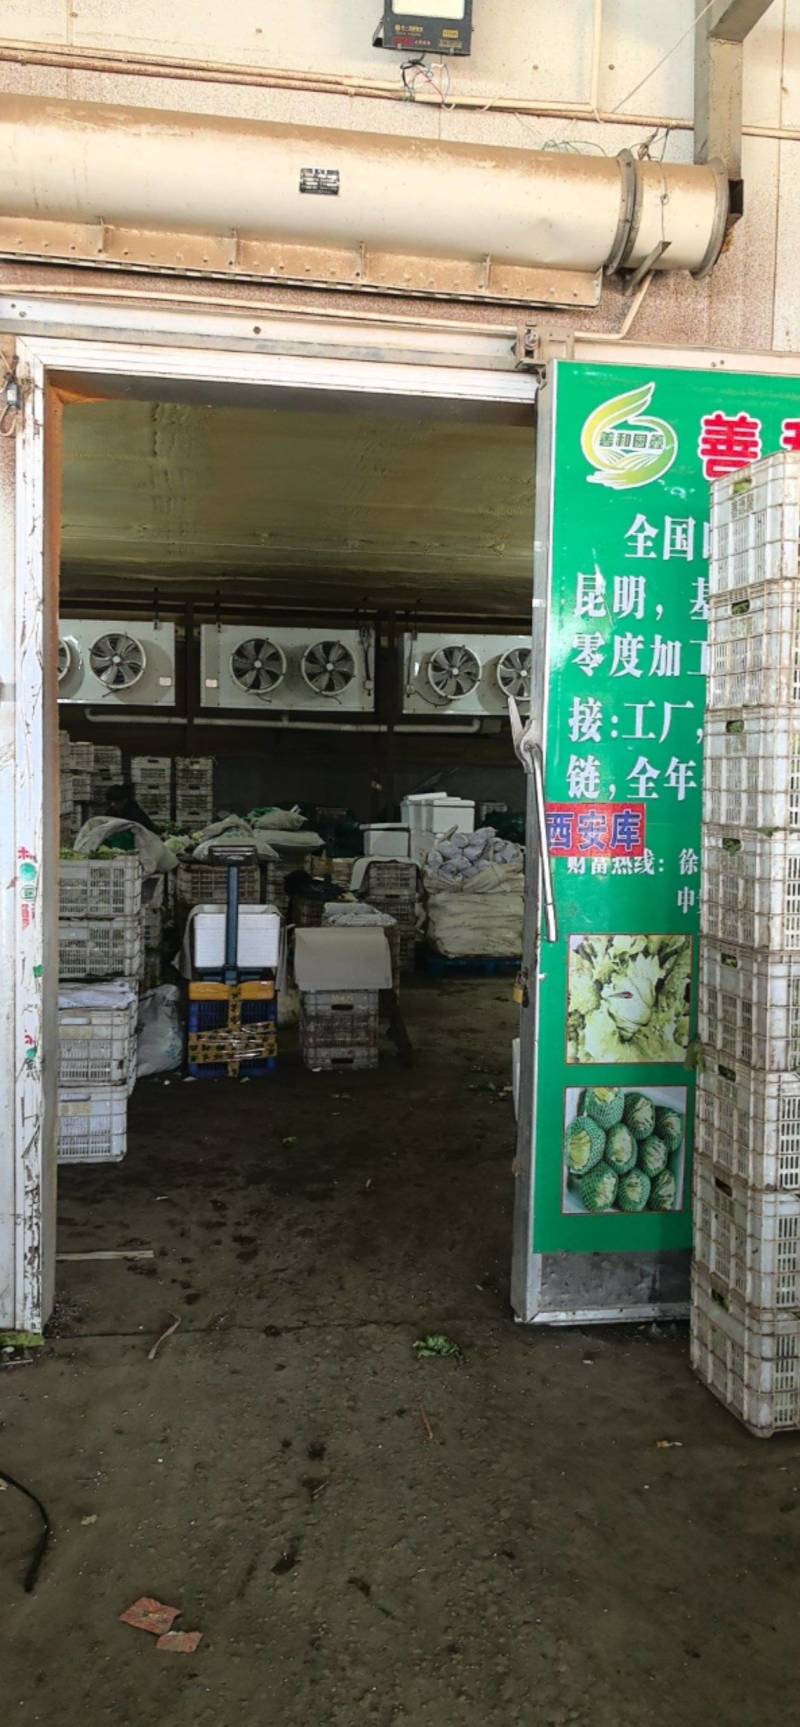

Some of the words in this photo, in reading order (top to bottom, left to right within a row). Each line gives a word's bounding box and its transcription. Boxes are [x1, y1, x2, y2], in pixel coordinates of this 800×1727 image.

[698, 411, 800, 481] 善
[624, 512, 710, 562] 全国
[545, 808, 641, 851] 西安库
[677, 886, 703, 915] 申
